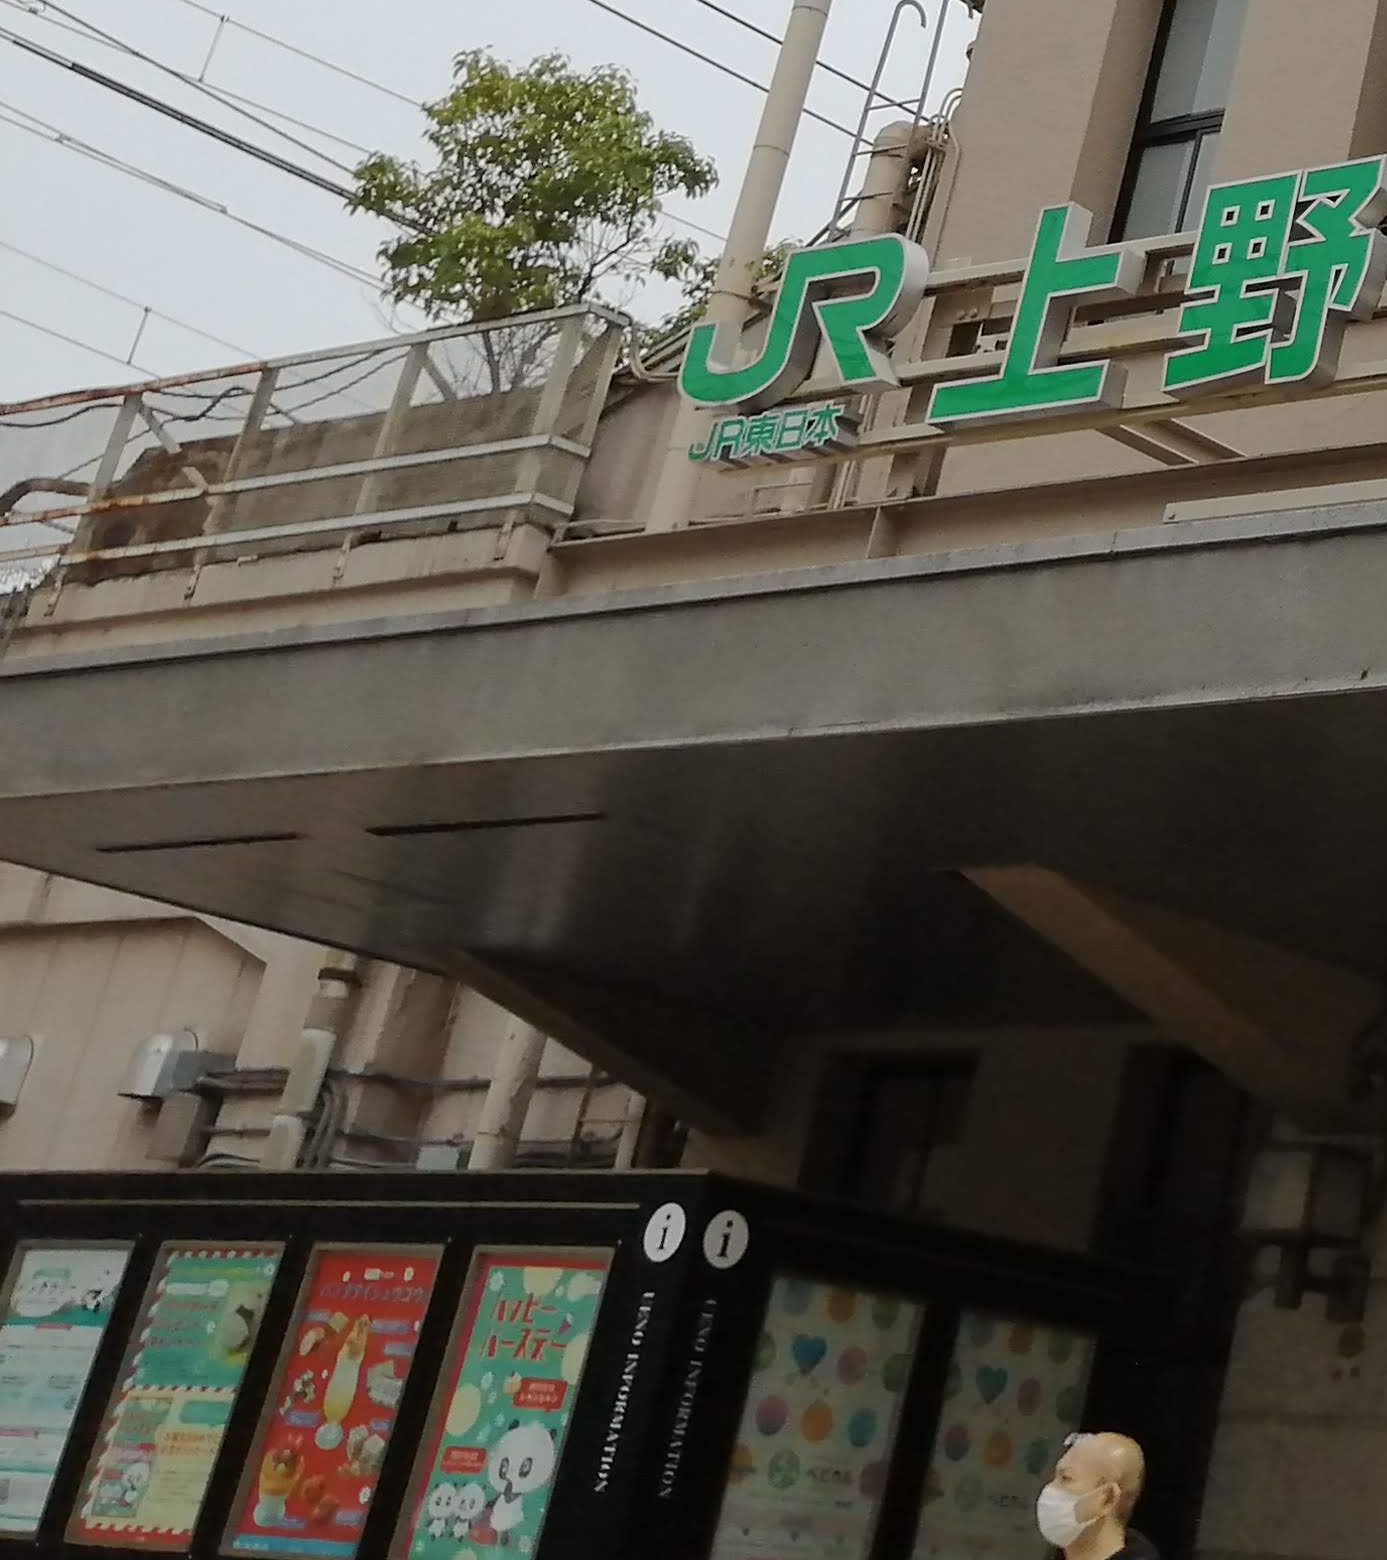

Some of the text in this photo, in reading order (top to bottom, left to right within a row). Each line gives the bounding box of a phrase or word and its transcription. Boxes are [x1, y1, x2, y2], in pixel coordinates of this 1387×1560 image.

[688, 401, 845, 462] JR東日本
[594, 1353, 640, 1492] INFORMATION
[658, 1360, 702, 1499] INFORMATION
